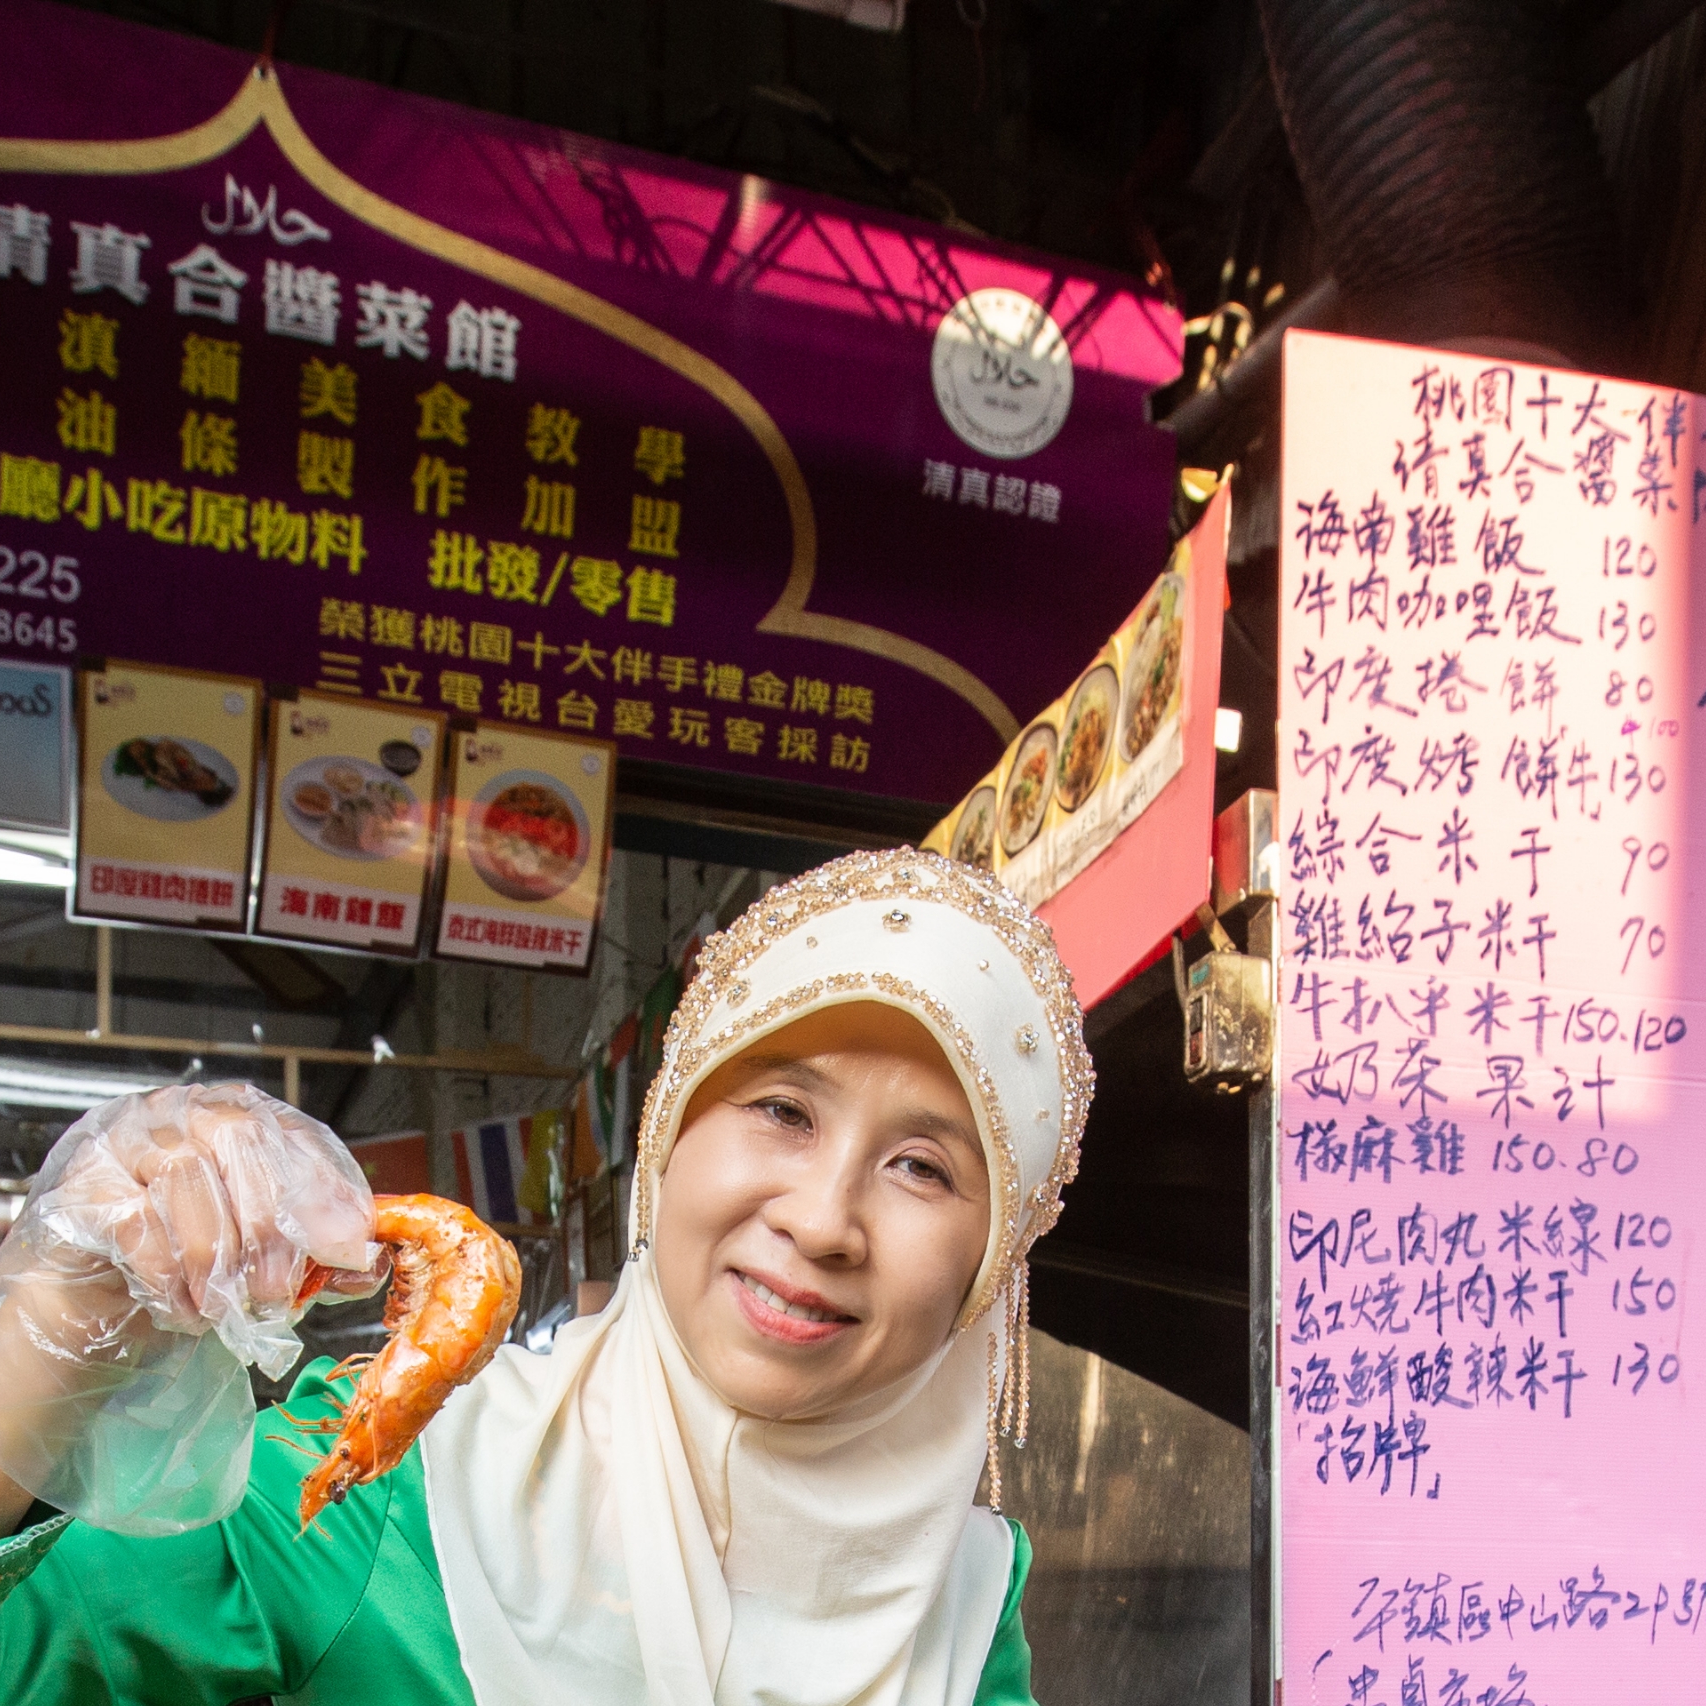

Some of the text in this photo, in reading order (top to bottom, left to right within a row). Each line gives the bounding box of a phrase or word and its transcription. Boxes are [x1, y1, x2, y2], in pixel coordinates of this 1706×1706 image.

[200, 172, 332, 245] حلال
[923, 457, 1063, 525] 清真認證
[1294, 488, 1657, 578] 海南雞飯 120
[427, 528, 677, 628] 批發/零售
[318, 597, 874, 725] 榮獲桃園十大伴手禮金牌獎
[1598, 602, 1657, 650] 130
[317, 650, 871, 772] 三立電視台愛玩客採訪
[1604, 670, 1654, 709] 80
[1608, 753, 1667, 801] 130
[1289, 805, 1670, 897] 綜合米干 90
[1620, 916, 1667, 975] 70
[1289, 1197, 1672, 1293] 印尼肉丸米線 120
[1290, 1264, 1677, 1345] 紅燒牛肉米干 150
[1288, 1332, 1681, 1418] 海鮮酸辣米干 130
